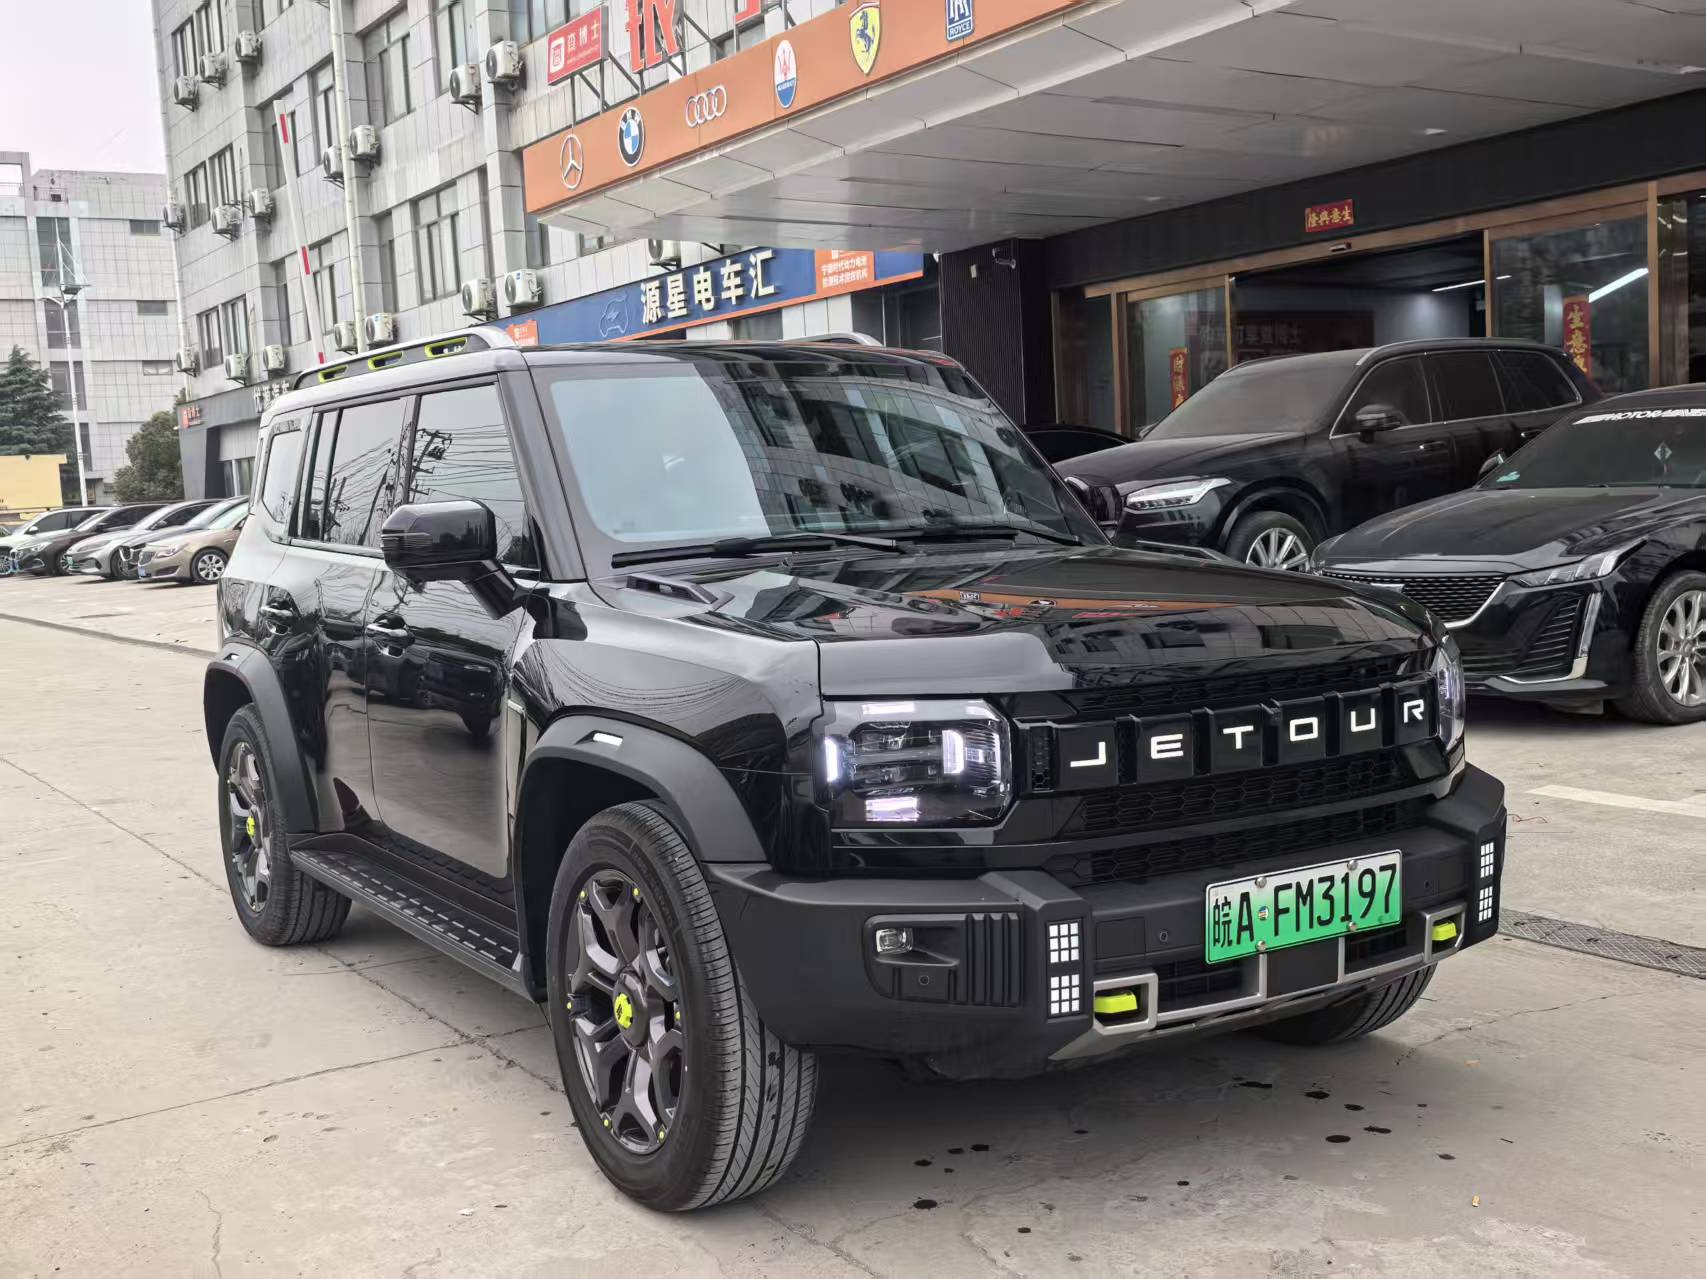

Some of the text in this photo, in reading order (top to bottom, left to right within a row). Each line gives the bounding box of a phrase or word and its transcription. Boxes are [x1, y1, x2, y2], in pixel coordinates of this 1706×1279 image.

[949, 21, 971, 37] ROYCE
[640, 248, 776, 324] 源星电车汇
[1070, 699, 1425, 768] JETOUR
